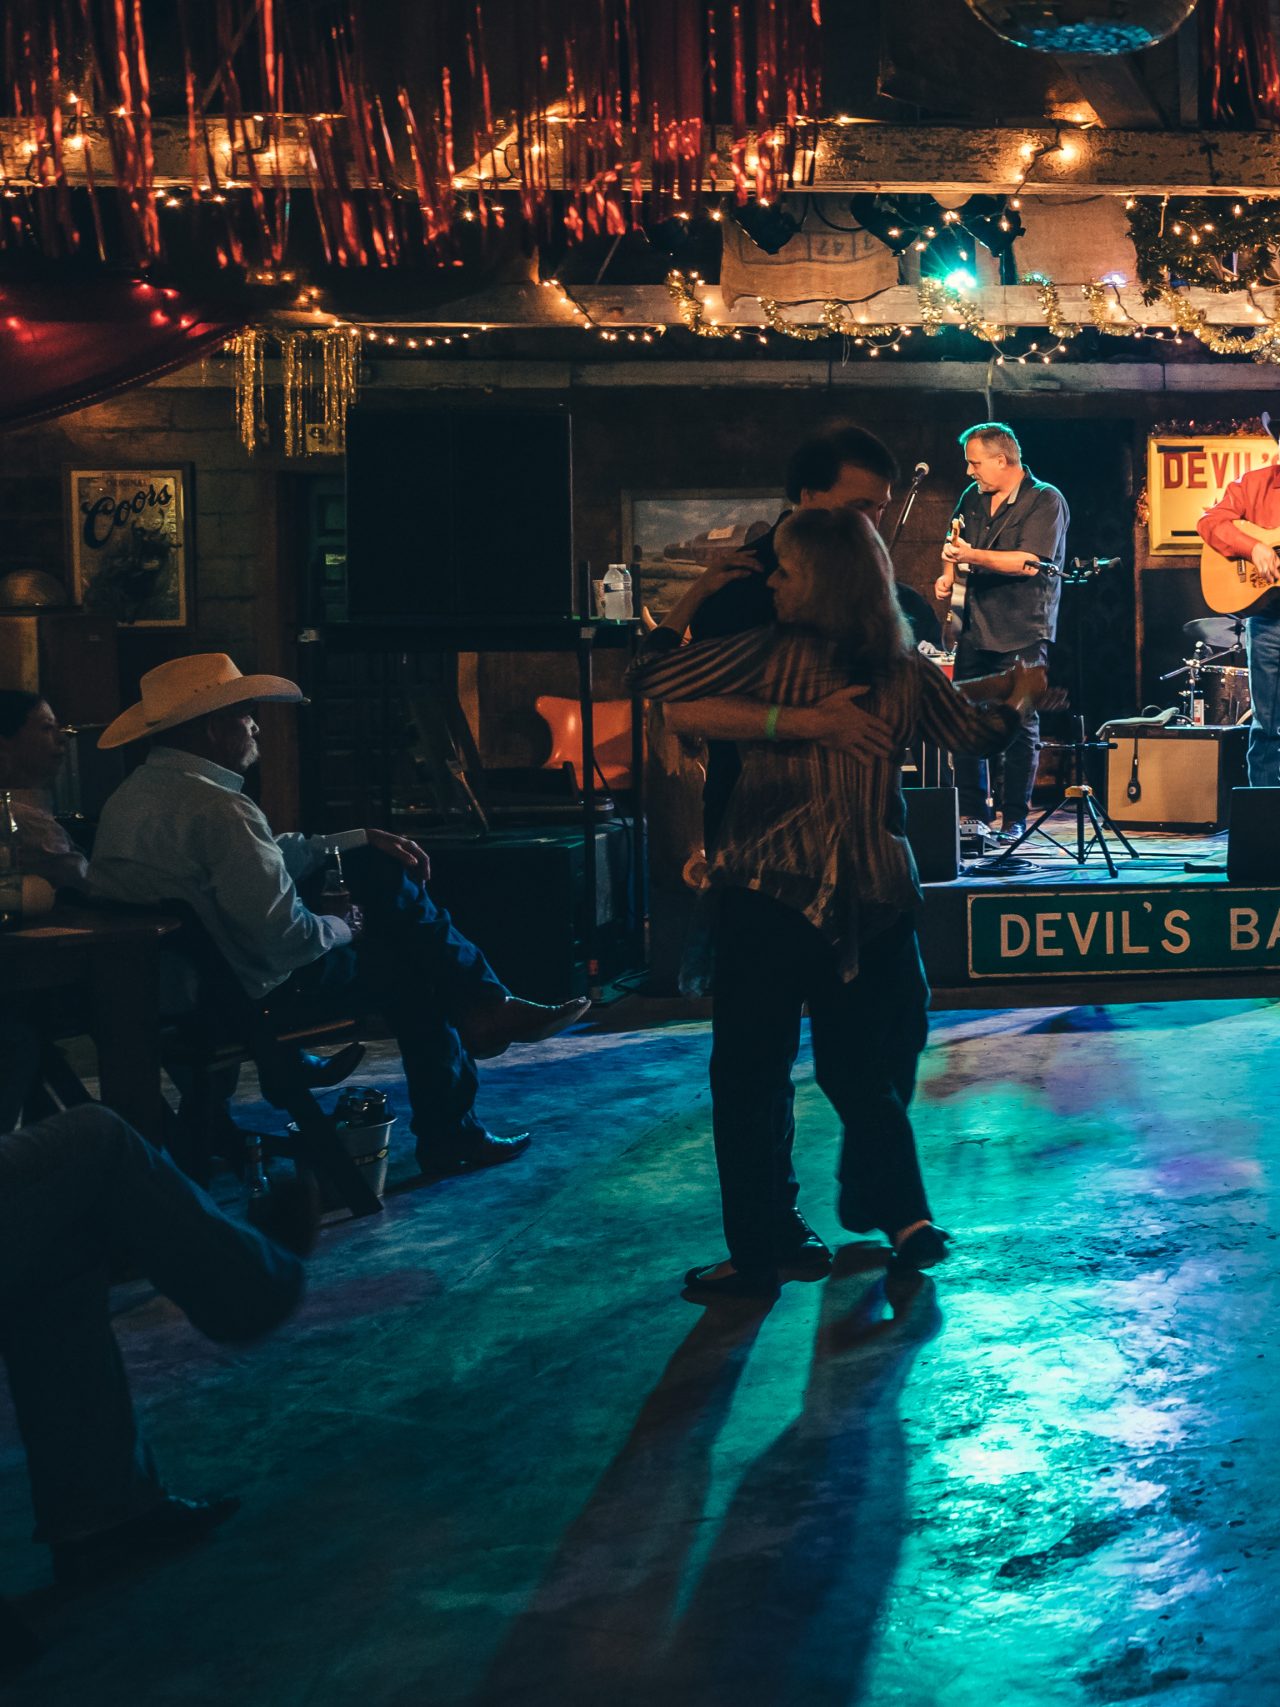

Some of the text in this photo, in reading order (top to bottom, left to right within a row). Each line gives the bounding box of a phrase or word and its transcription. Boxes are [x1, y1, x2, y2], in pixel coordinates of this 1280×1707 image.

[1163, 452, 1280, 489] DEVI'
[80, 484, 172, 549] Coors
[1000, 901, 1192, 957] DEVIL'S
